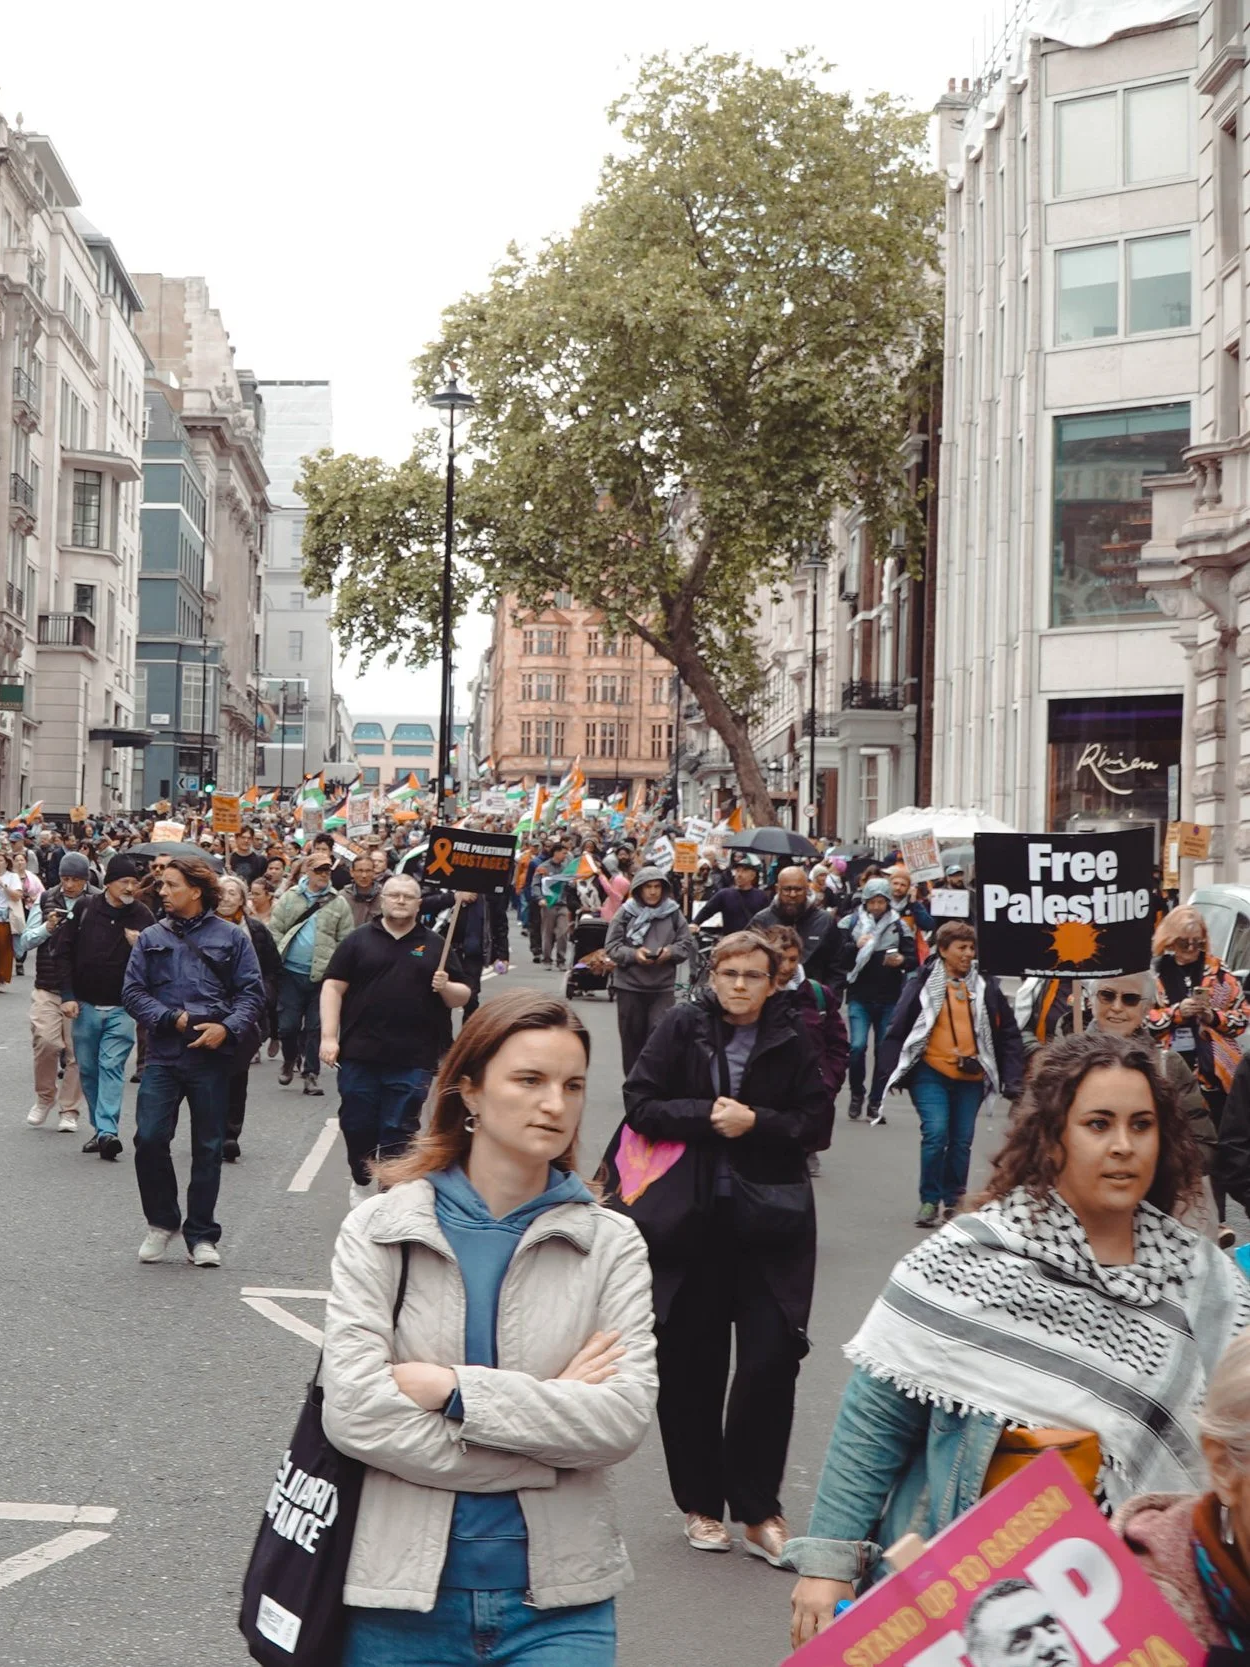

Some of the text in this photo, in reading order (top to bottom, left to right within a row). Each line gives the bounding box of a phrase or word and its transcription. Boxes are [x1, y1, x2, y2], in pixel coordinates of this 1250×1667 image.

[451, 852, 510, 871] HOSTAGES
[453, 842, 471, 852] FREE
[1028, 843, 1118, 882] Free
[983, 884, 1149, 925] Palestine
[842, 1485, 1073, 1667] STAND UP TO RACISM
